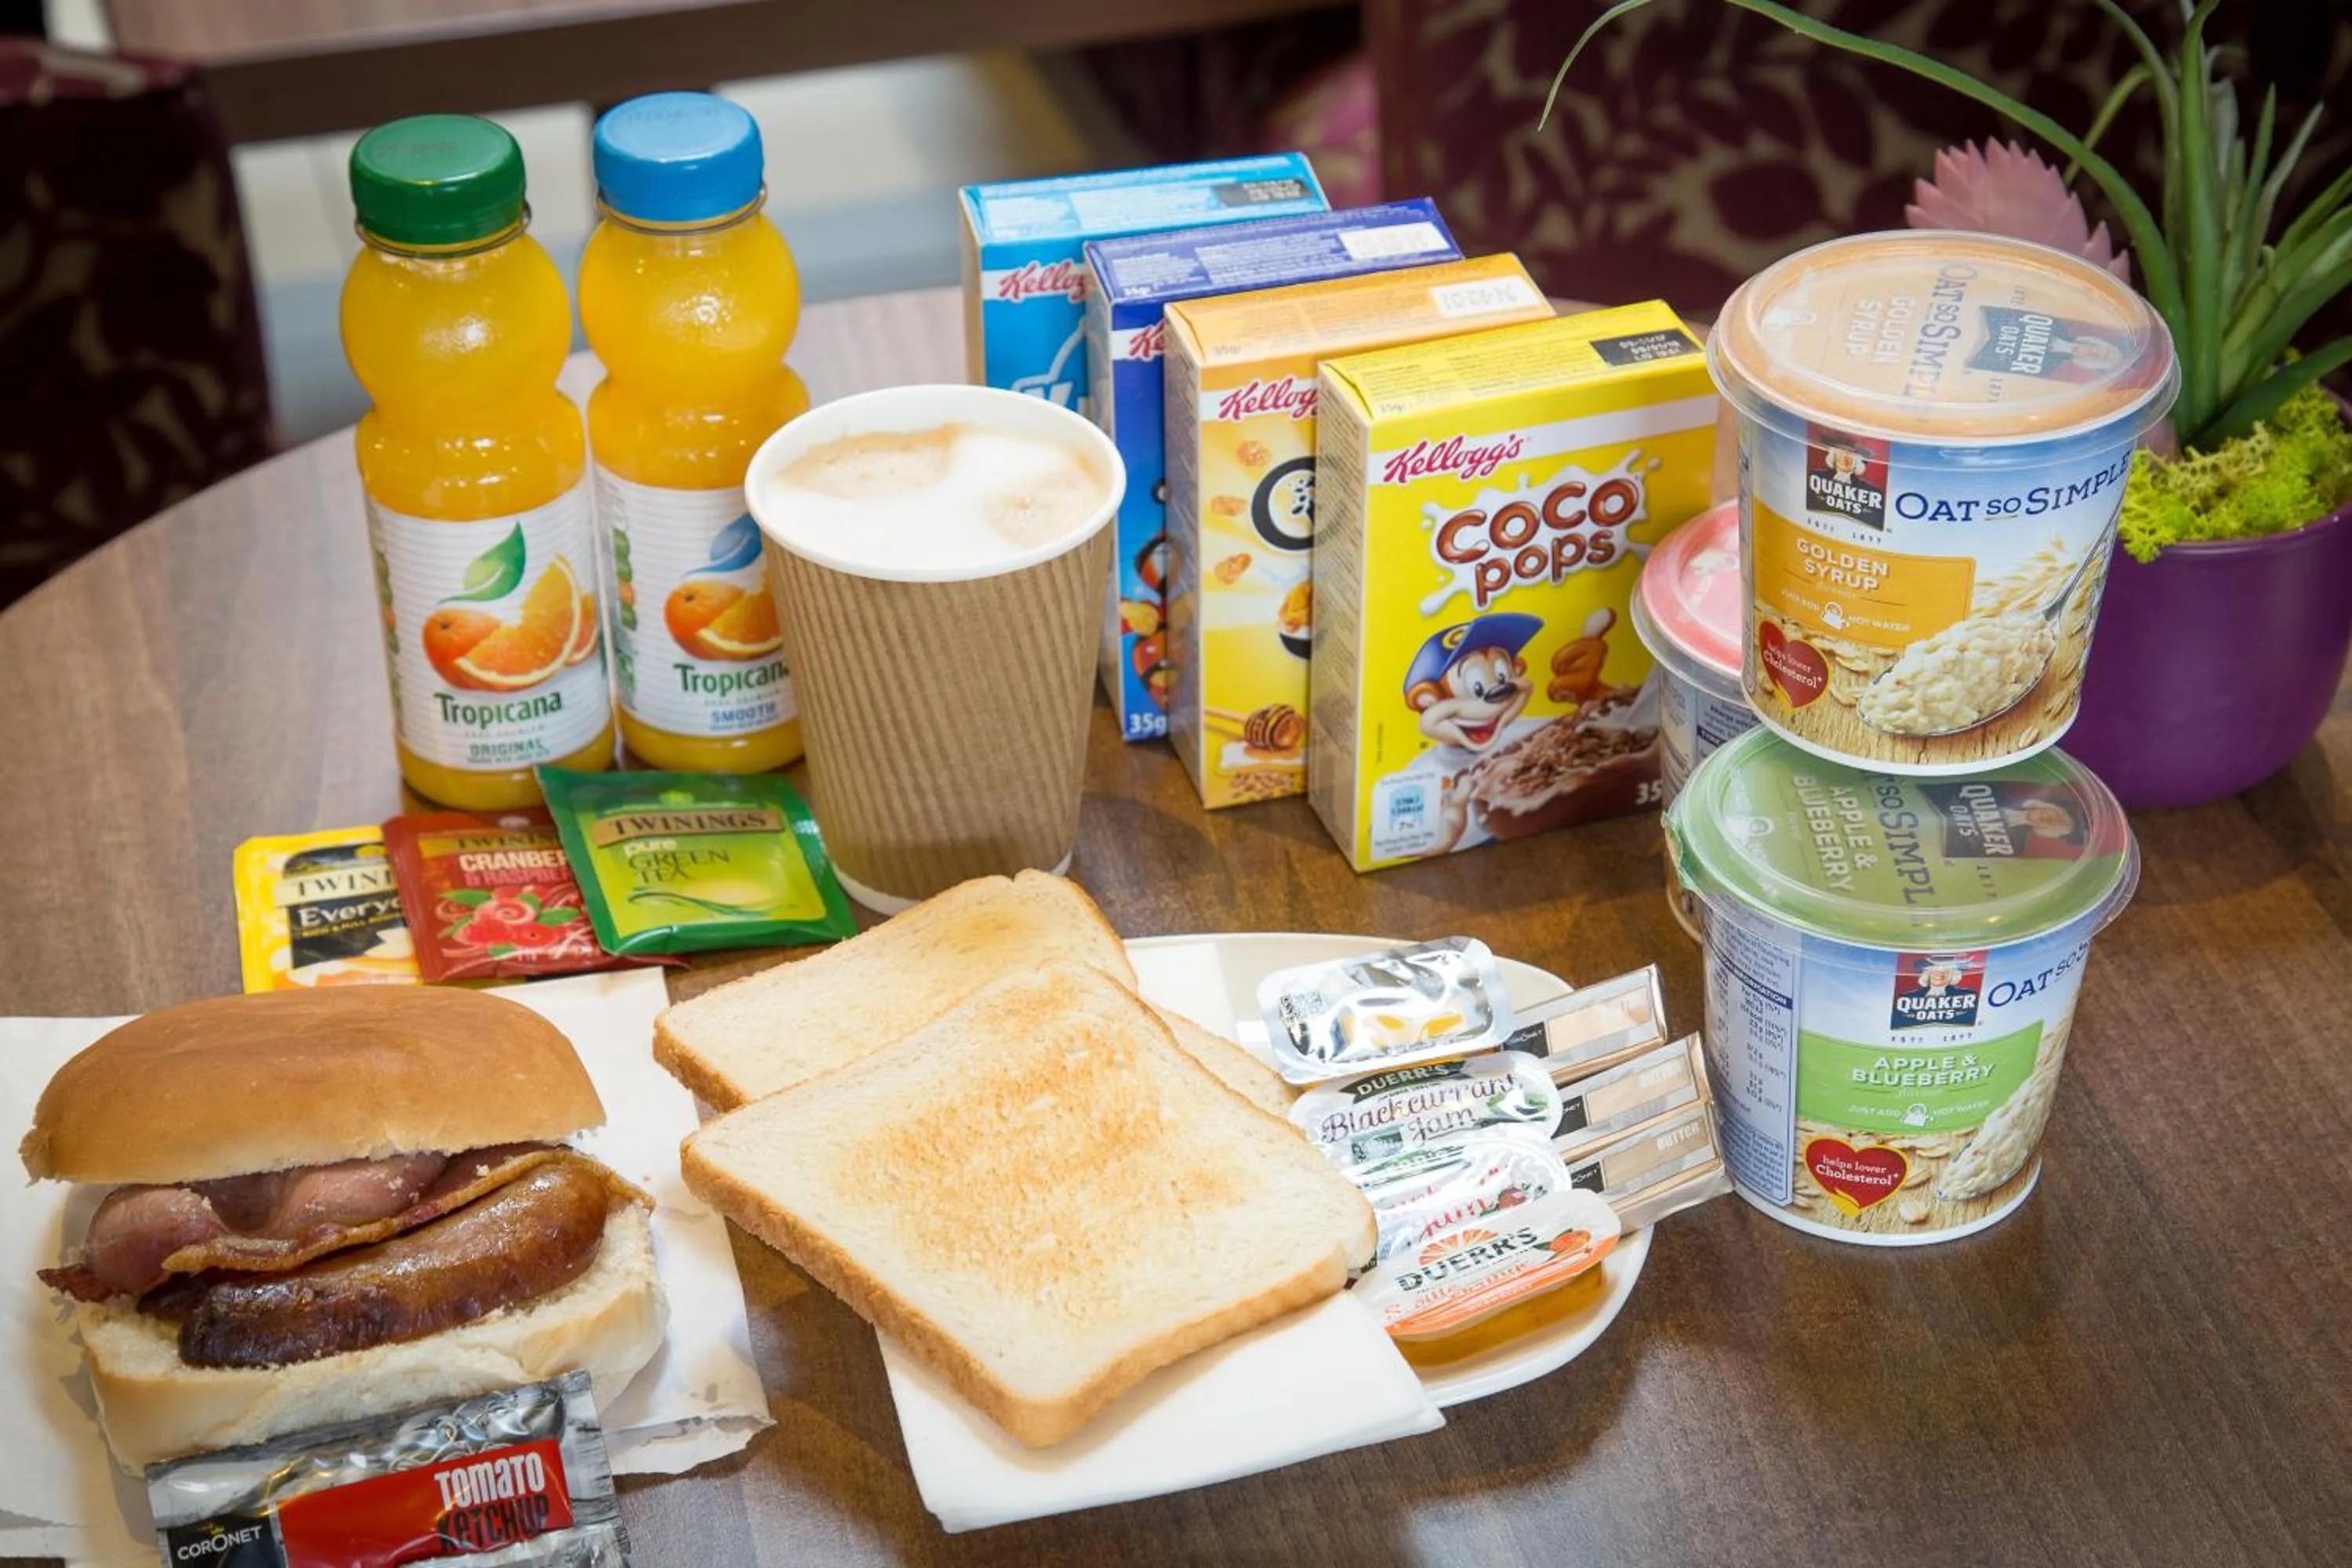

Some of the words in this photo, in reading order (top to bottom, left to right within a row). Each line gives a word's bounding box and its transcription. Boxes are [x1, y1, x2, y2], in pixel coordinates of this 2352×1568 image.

[1847, 299, 1882, 357] SYRUP
[1874, 296, 1915, 364] GOLDEN
[1995, 325, 2020, 355] OATS
[2010, 314, 2053, 375] QUAKER
[1902, 322, 1962, 398] SIMPL
[1218, 378, 1317, 419] Kellog
[1384, 434, 1524, 483] Kellogg's
[1809, 474, 1882, 509] QUAKER
[1895, 492, 1980, 521] OAT
[2025, 451, 2131, 514] SIMPLE
[1826, 495, 1862, 514] OATS
[1796, 537, 1888, 577] GOLDEN
[1805, 558, 1879, 590] SYRUP
[434, 691, 562, 729] Tropicana
[711, 702, 775, 723] SMOOTH
[470, 738, 545, 756] ORIGINAL
[611, 812, 767, 835] TWININGS
[1792, 775, 1855, 893] BLUEBERRY
[1829, 786, 1872, 850] APPLE
[1854, 852, 1878, 870] &
[1950, 805, 1979, 838] OATS
[1961, 784, 2014, 856] QUAKER
[624, 838, 677, 857] pure
[629, 848, 730, 870] GREEN
[1878, 811, 1936, 905] SIMPL
[1896, 994, 1976, 1014] QUAKER
[1987, 969, 2053, 1007] OAT
[1917, 1009, 1955, 1021] OATS
[1356, 1064, 1448, 1096] DUERR'S
[1852, 1063, 1995, 1087] BLUEBERRY
[1875, 1056, 1957, 1071] APPLE
[1962, 1054, 1979, 1066] &
[1321, 1073, 1515, 1142] Blackcurrant
[1657, 1121, 1700, 1151] BUTTER
[1823, 1154, 1853, 1169] helps
[1855, 1161, 1887, 1174] lower
[1395, 1227, 1538, 1291] DUERR'S
[177, 1526, 262, 1561] CORONET
